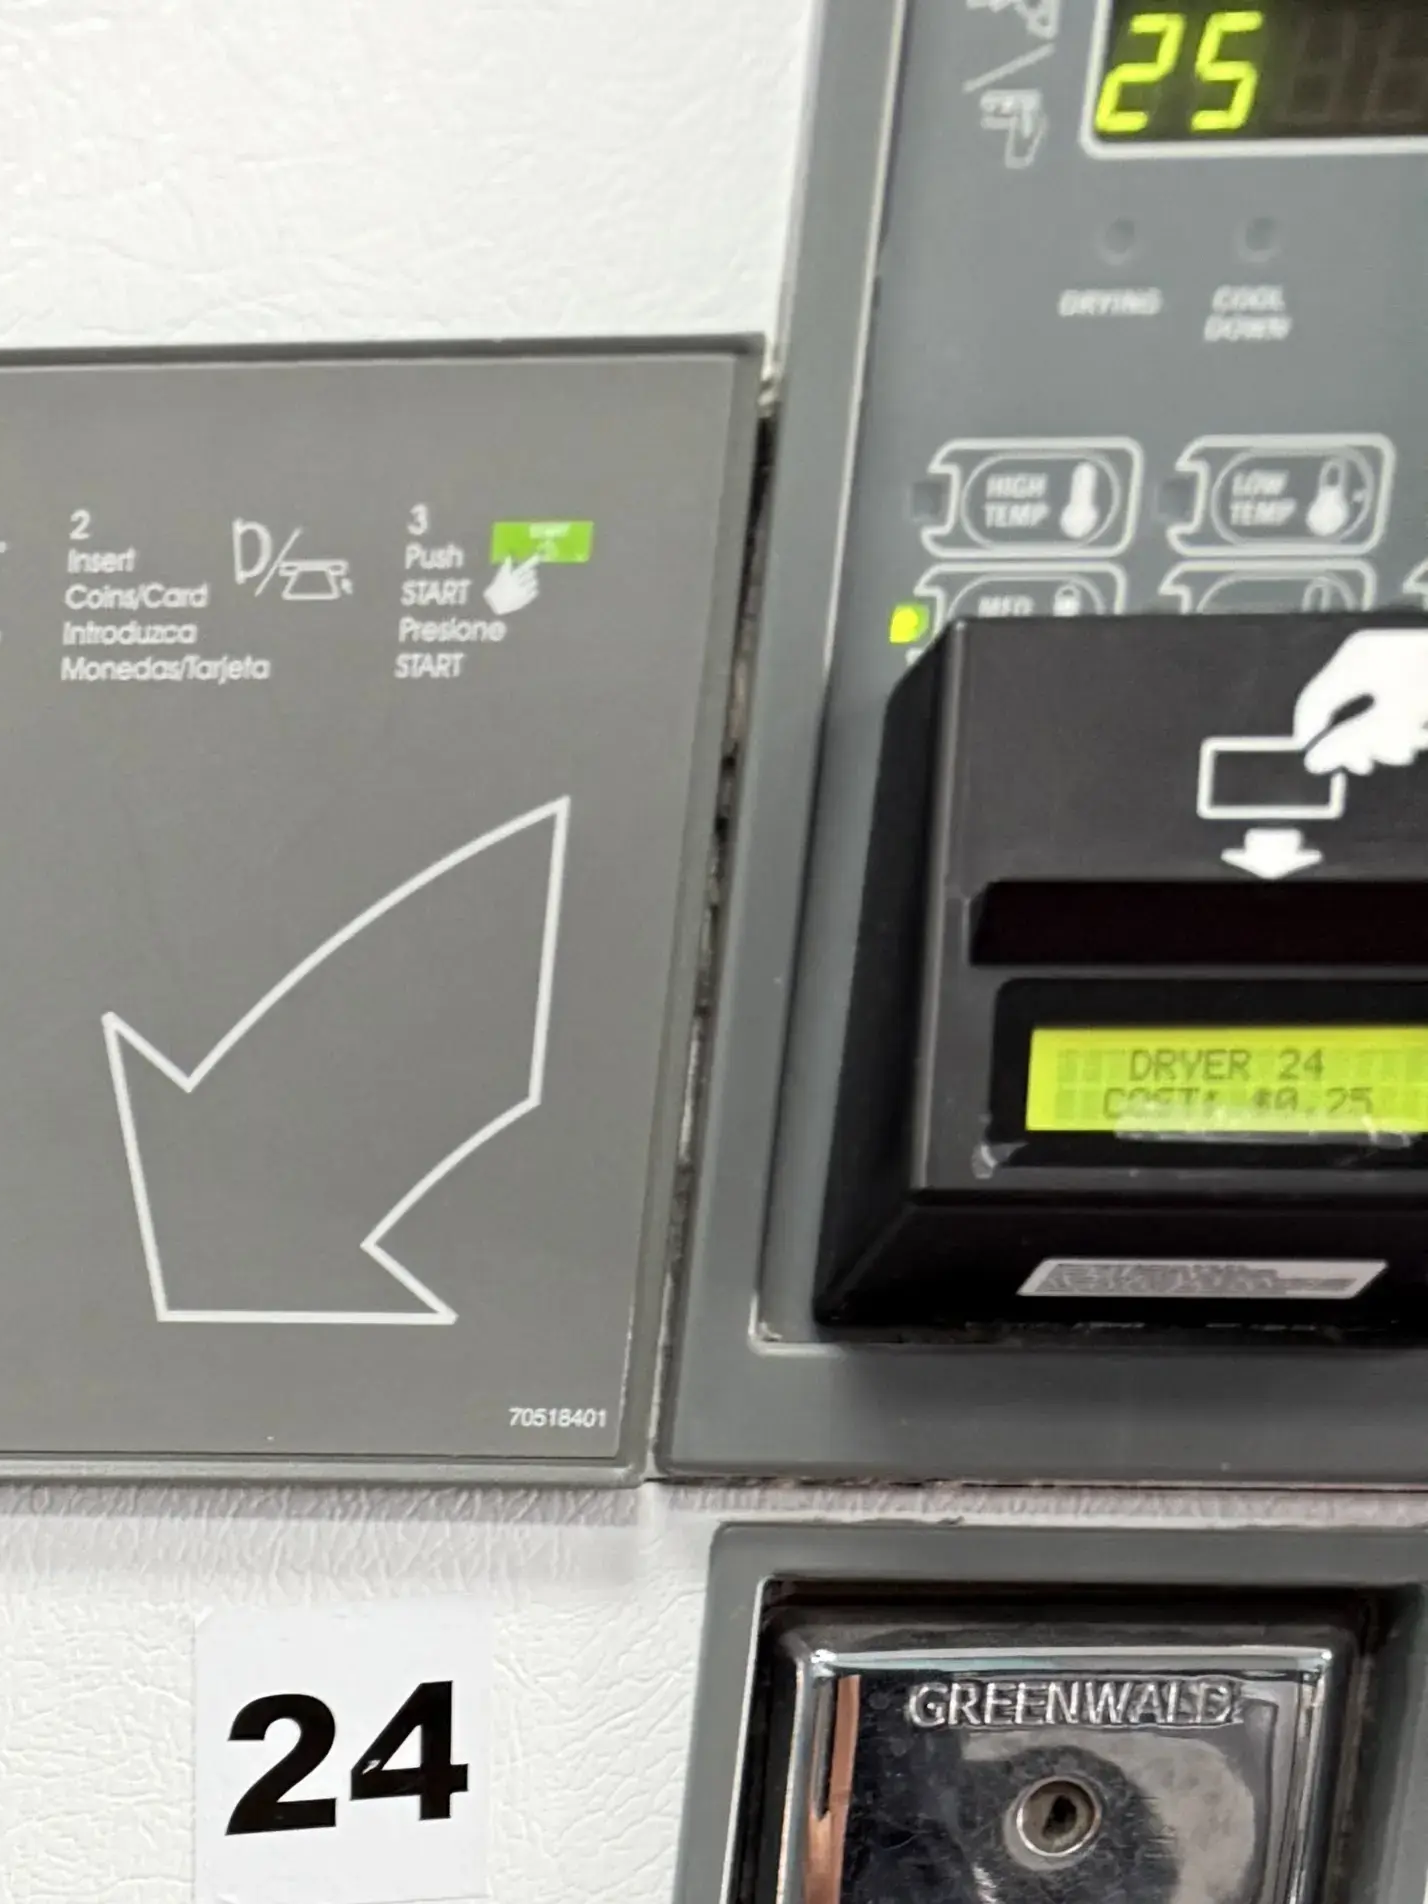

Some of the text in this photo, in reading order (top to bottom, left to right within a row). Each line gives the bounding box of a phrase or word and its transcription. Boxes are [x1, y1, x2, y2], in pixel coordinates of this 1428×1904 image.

[1094, 11, 1262, 132] 25
[985, 473, 1046, 498] HIGH
[1230, 470, 1288, 495] LOW
[69, 509, 91, 540] 2
[407, 504, 429, 536] 3
[982, 503, 1049, 528] TEMP
[1227, 499, 1296, 526] TEMP
[67, 545, 136, 573] Insert
[404, 542, 464, 570] Push
[64, 581, 209, 610] Coins/Card
[400, 578, 472, 606] START
[62, 620, 198, 645] Introduzca
[398, 616, 507, 643] Presione
[61, 653, 271, 685] Monedas/Tarjeta
[394, 651, 467, 679] START
[1128, 1048, 1324, 1081] DRYER 24
[508, 1407, 608, 1427] 70518401
[908, 1680, 1236, 1727] GREENWALD
[224, 1680, 470, 1836] 24
